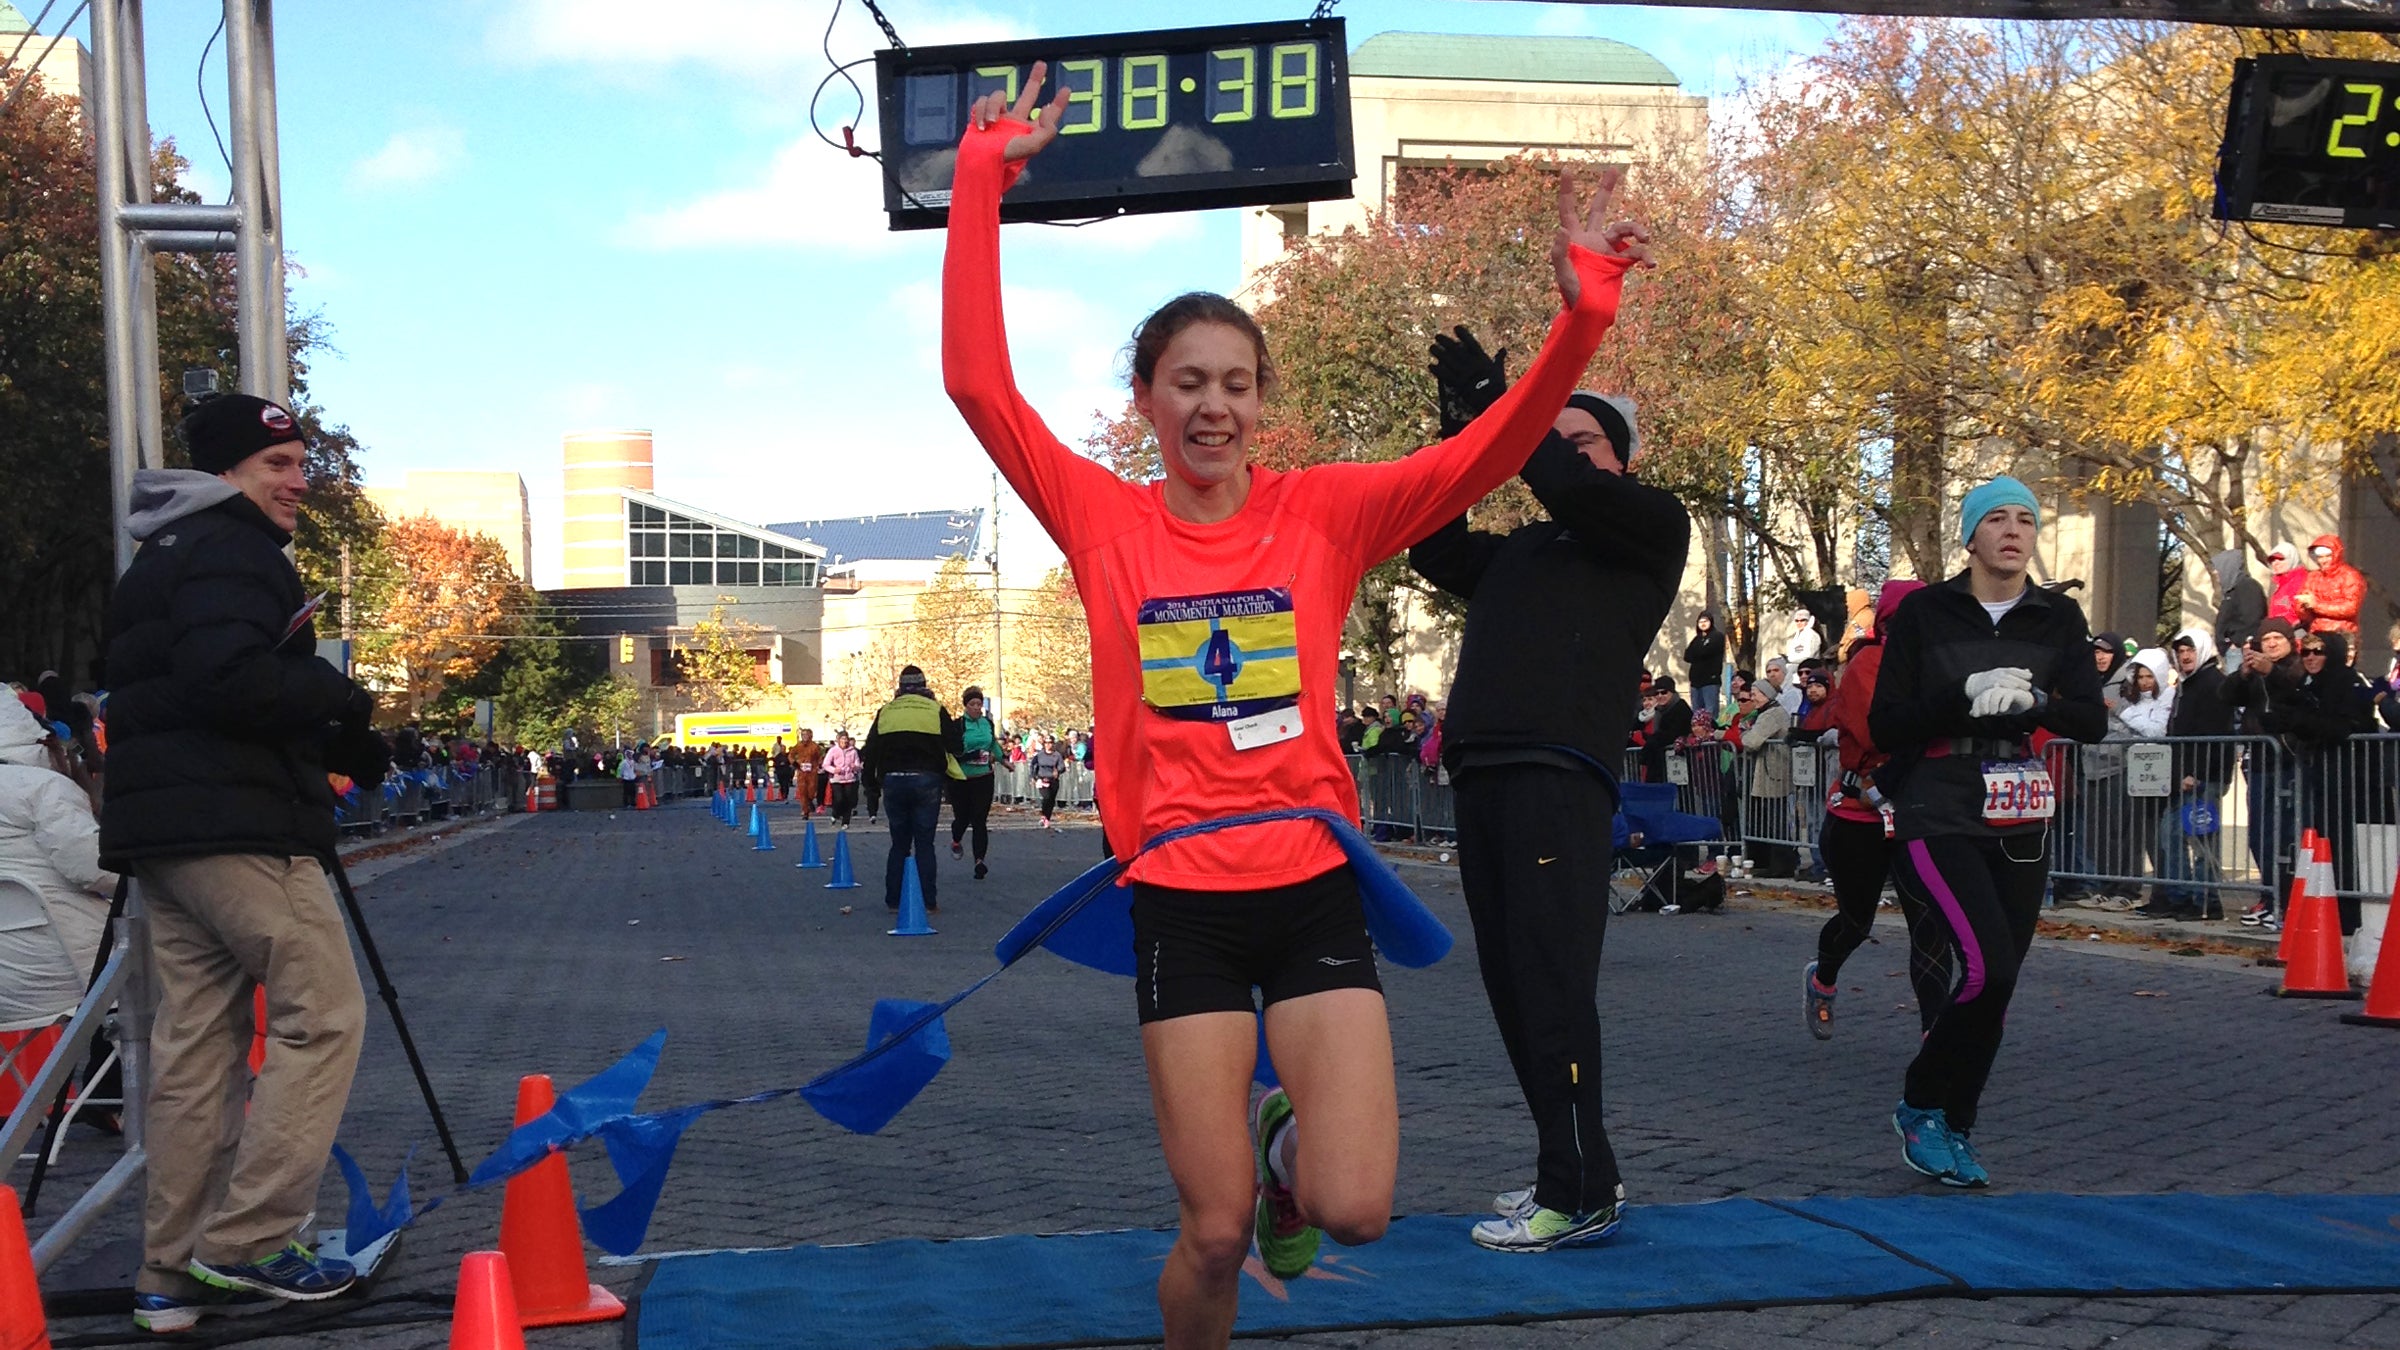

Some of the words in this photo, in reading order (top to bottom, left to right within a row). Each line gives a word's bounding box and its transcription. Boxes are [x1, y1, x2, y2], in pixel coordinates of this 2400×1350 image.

[1154, 605, 1220, 623] MONUMENTAL
[1222, 599, 1275, 617] MARATHON
[1166, 601, 1187, 610] 2014
[1191, 594, 1266, 608] INDIANAPOLIS
[1204, 629, 1237, 686] 4
